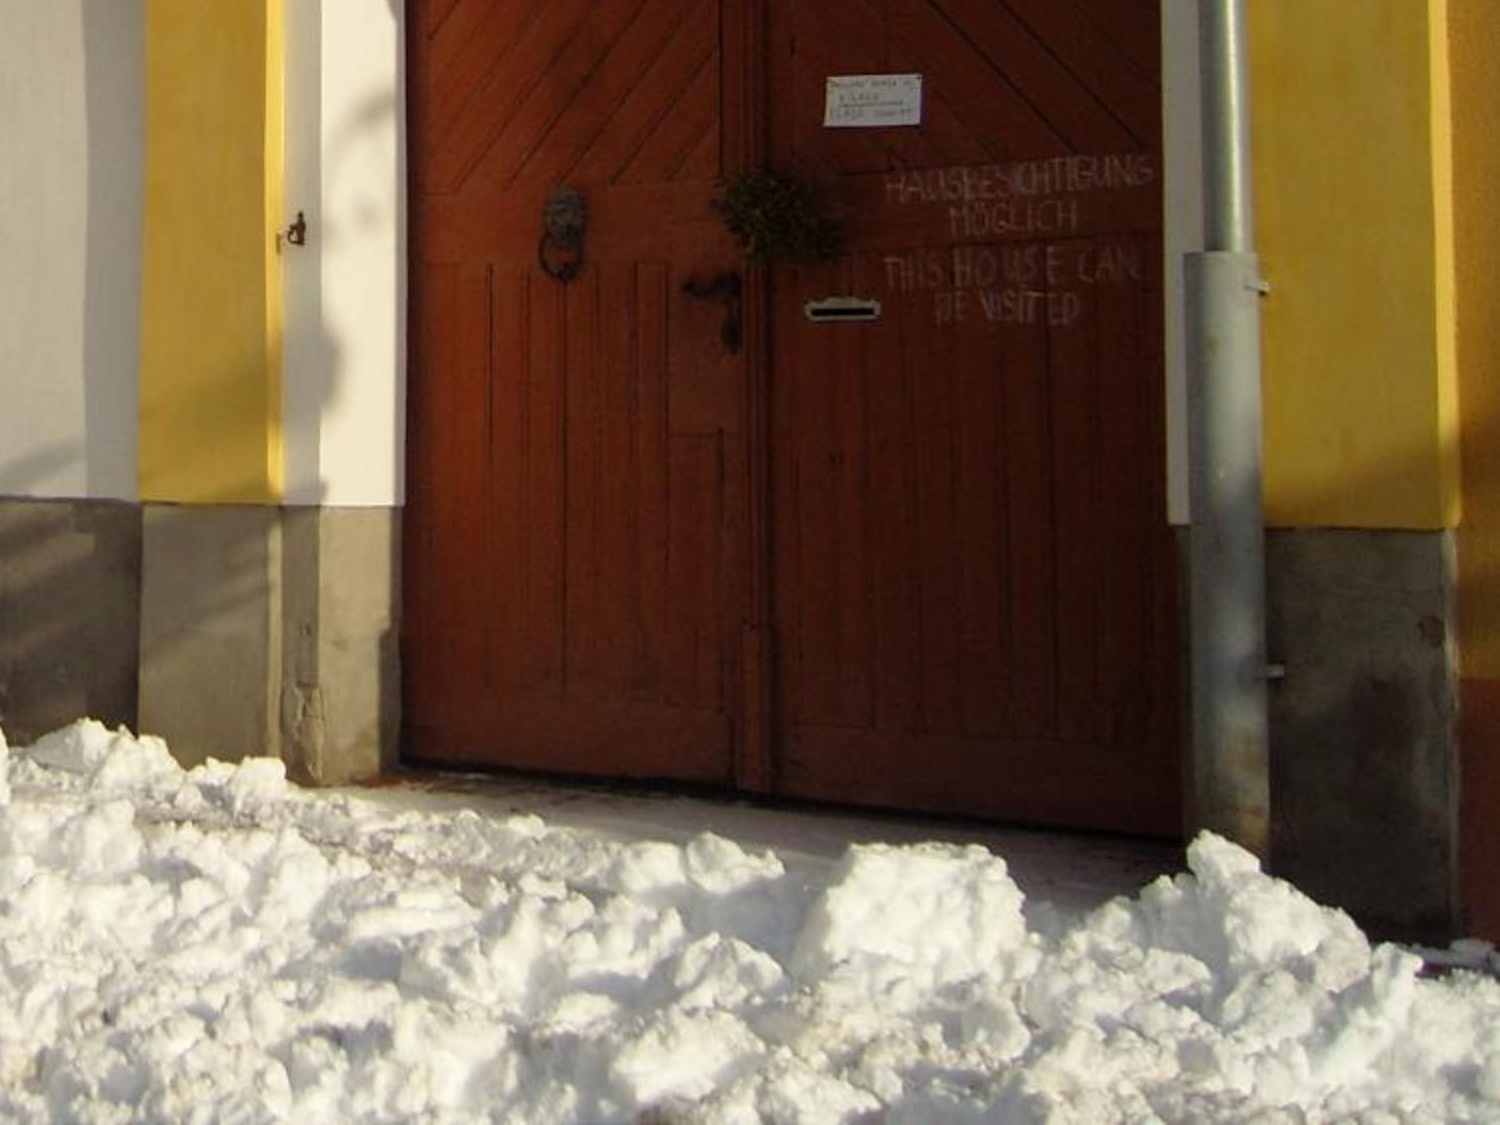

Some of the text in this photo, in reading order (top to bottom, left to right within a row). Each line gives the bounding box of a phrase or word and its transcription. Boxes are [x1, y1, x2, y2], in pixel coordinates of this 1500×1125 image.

[948, 198, 1078, 238] MÖGLICH
[883, 251, 944, 291] THIS
[952, 245, 1061, 287] HOUSE
[933, 288, 1079, 327] BE VISITED
